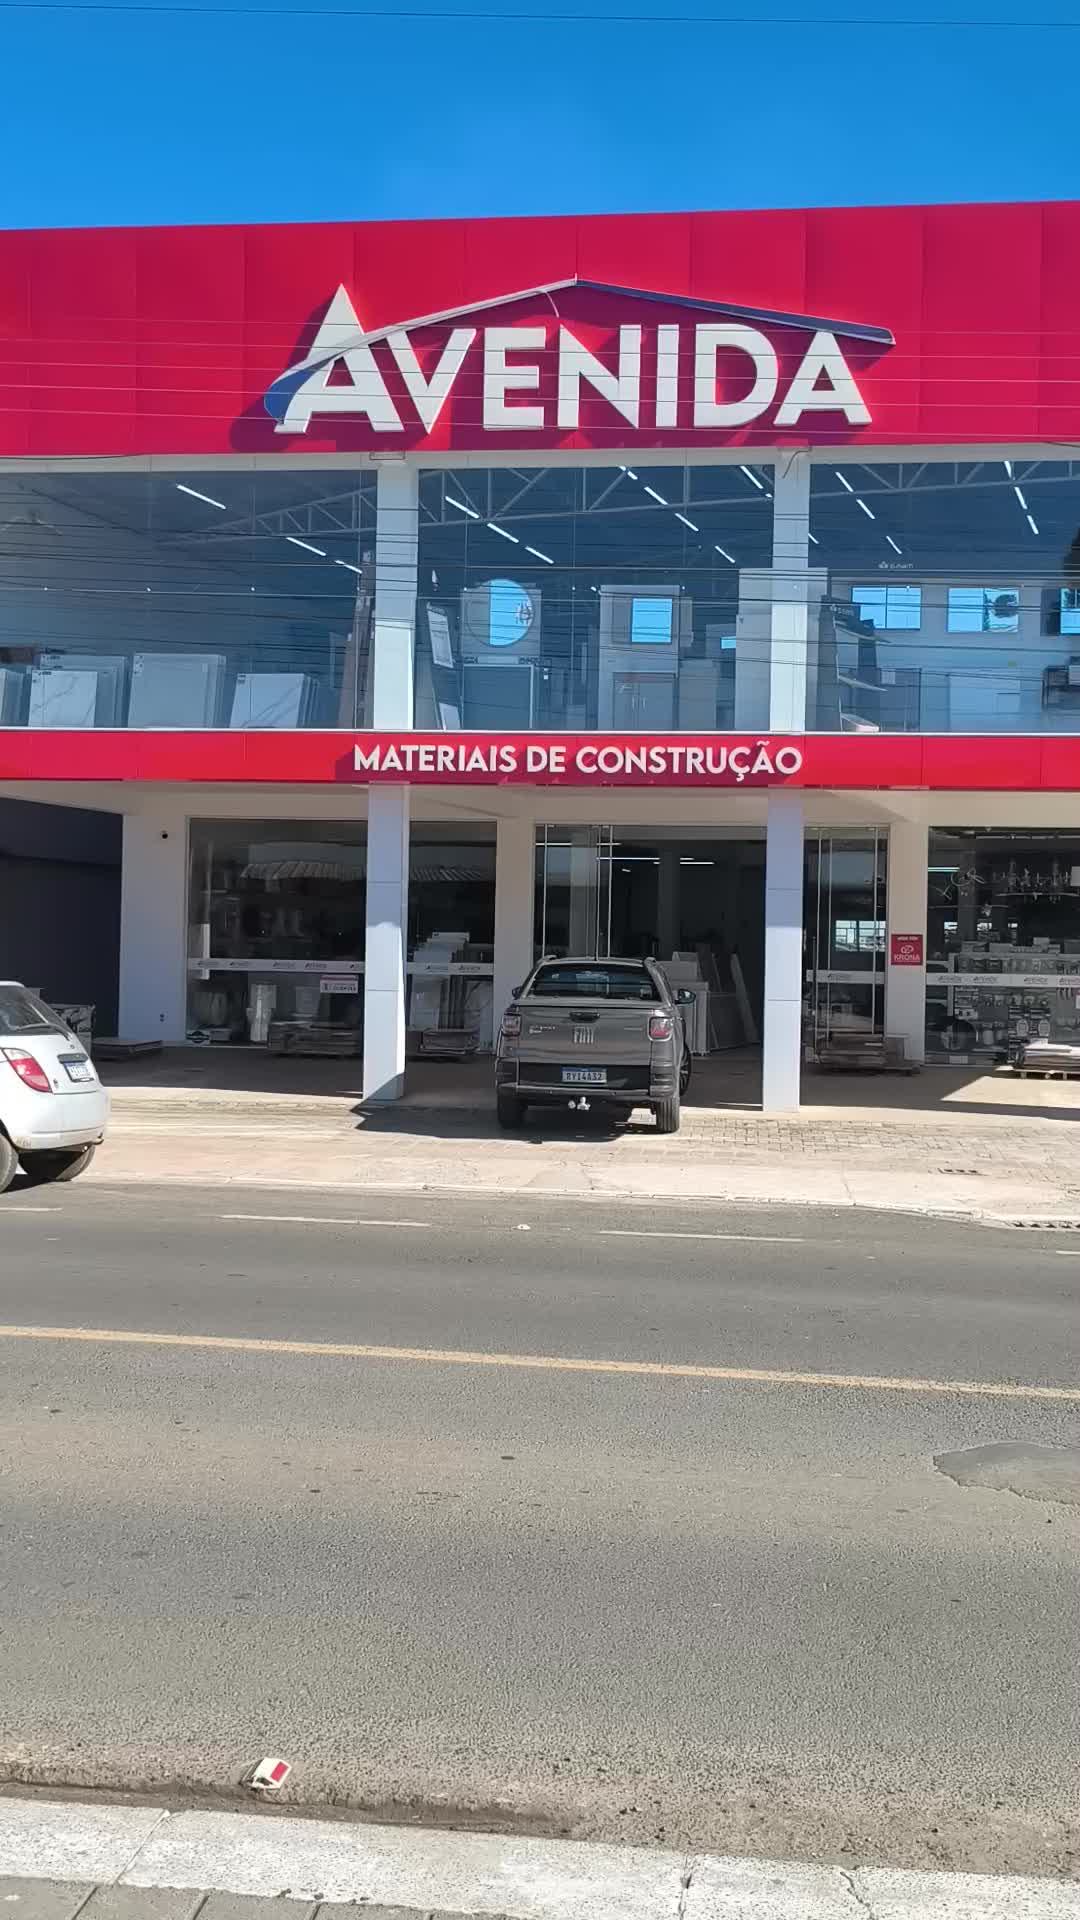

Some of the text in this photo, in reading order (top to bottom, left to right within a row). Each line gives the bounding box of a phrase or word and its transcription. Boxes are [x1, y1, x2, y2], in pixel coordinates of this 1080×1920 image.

[273, 283, 873, 435] AVENIDA
[353, 740, 804, 782] MATERIAIS DE CONSTRUÇÃO
[893, 953, 921, 961] KRONA
